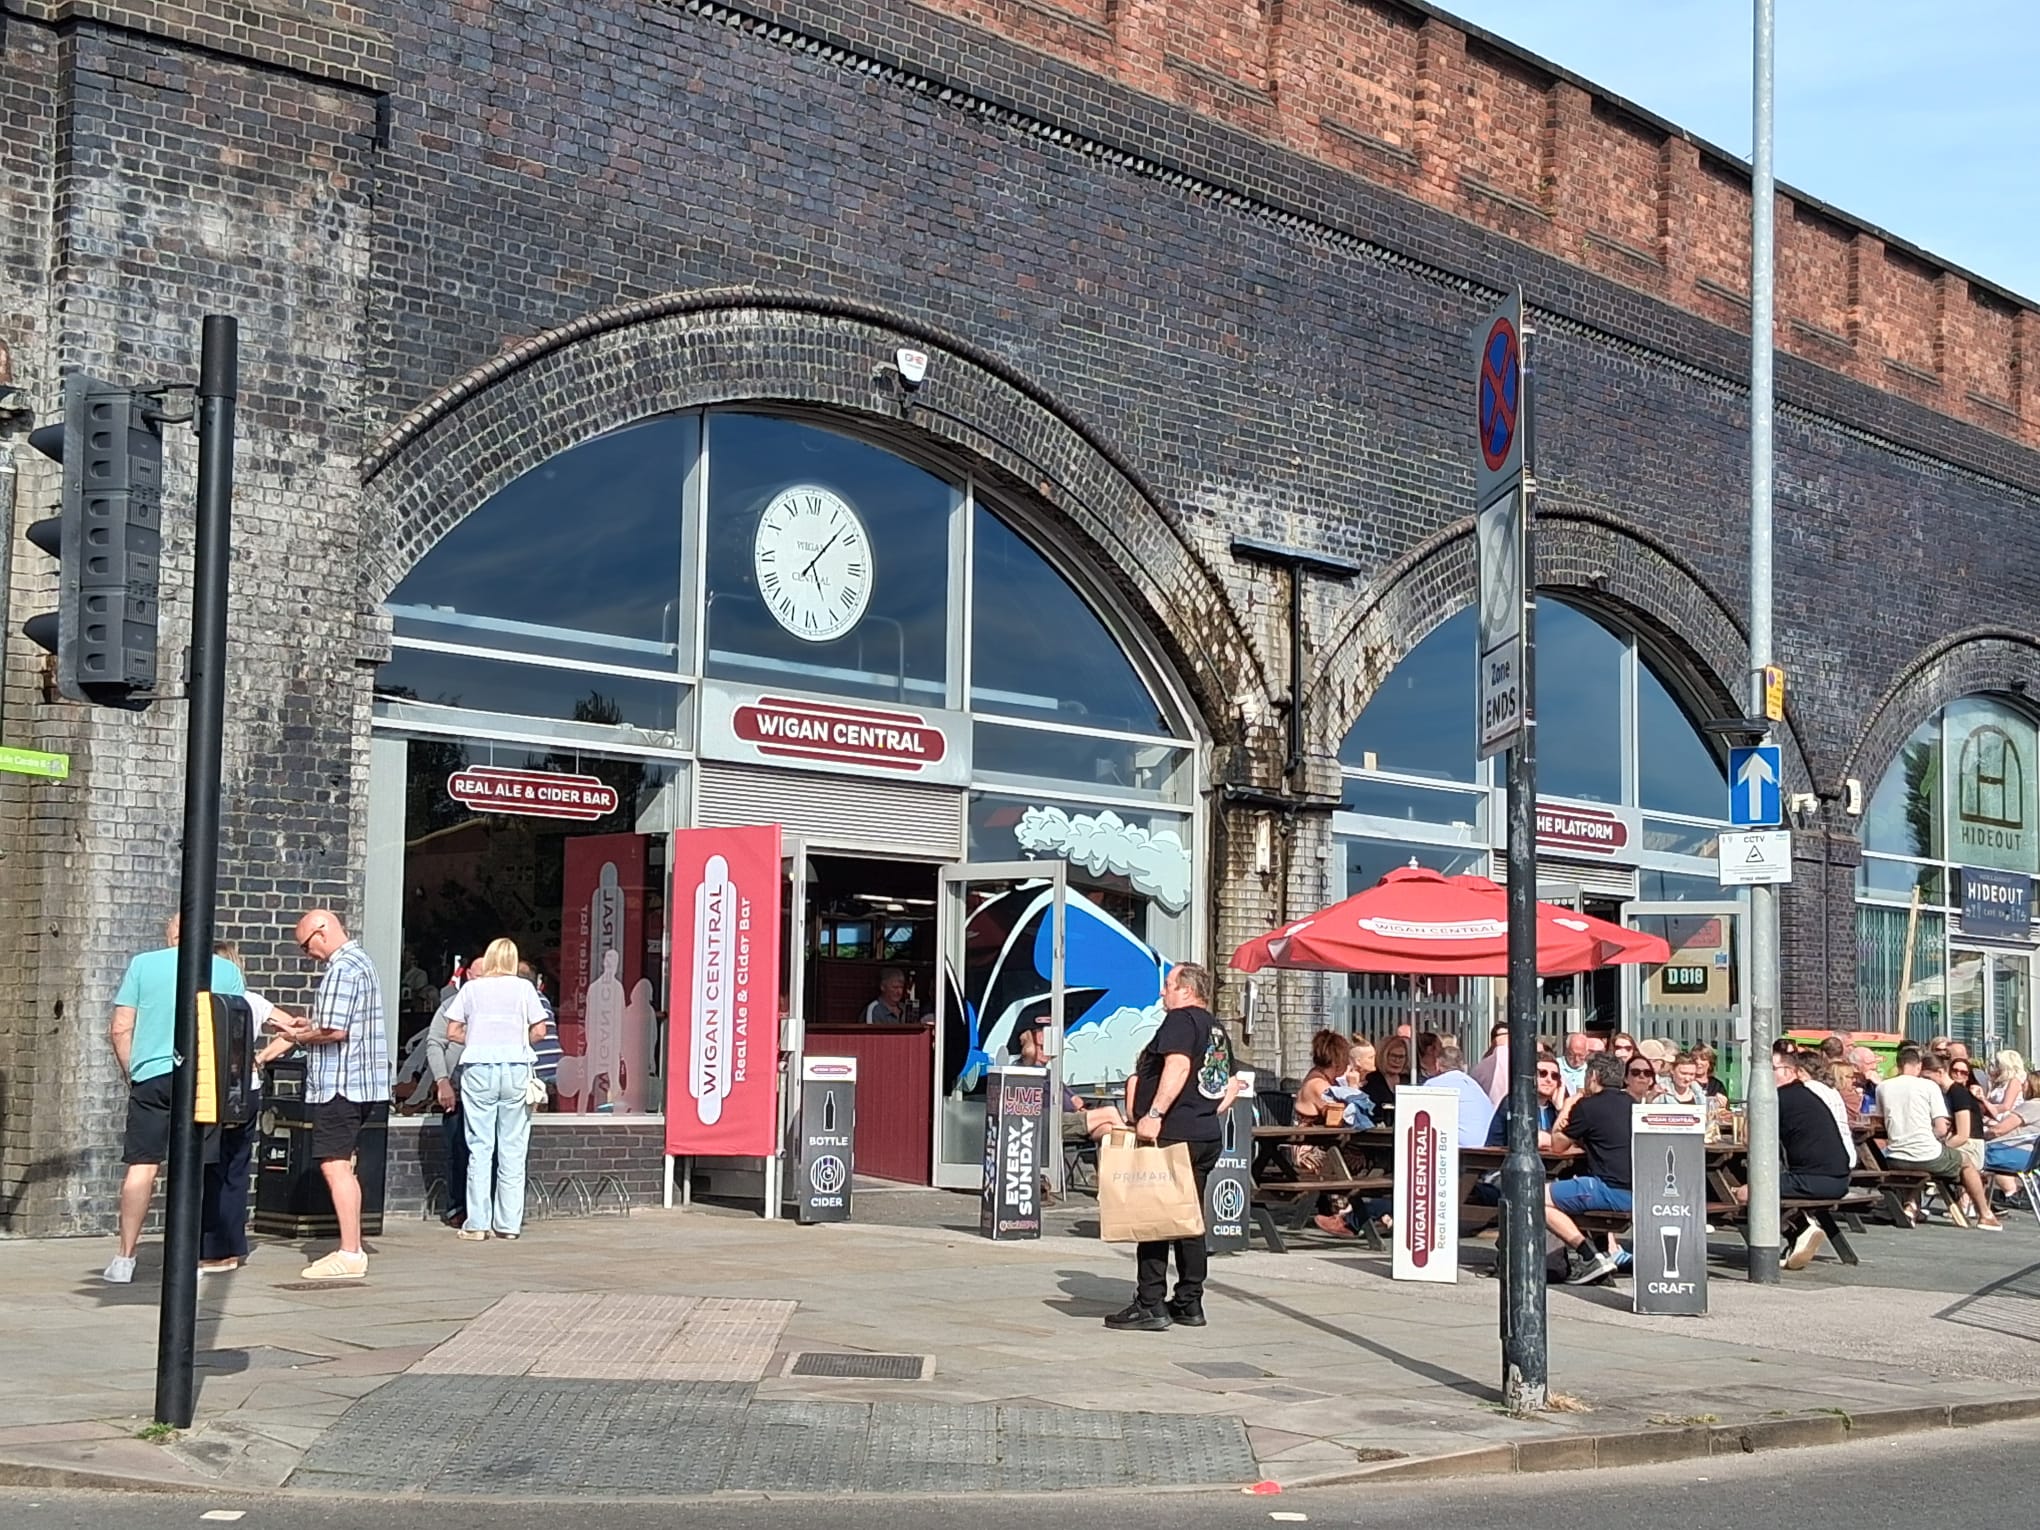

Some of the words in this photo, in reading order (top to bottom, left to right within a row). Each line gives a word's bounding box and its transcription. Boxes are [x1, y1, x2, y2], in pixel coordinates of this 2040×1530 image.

[1491, 661, 1510, 687] Zone
[1486, 687, 1516, 729] ENDS
[756, 713, 829, 742] WIGAN
[833, 723, 925, 753] CENTRAL
[455, 779, 493, 795] REAL
[495, 783, 522, 798] ALE
[524, 787, 535, 799] &
[538, 788, 580, 803] CIDER
[583, 792, 611, 806] BAR
[1536, 816, 1553, 832] HE
[1555, 818, 1613, 840] PLATFORM
[1744, 835, 1765, 843] CCTV
[1962, 827, 2021, 850] HIDEOUT
[1968, 882, 2024, 905] HIDEOUT
[739, 897, 751, 931] Bar
[1375, 923, 1426, 933] WIGAN
[1430, 924, 1497, 934] CENTRAL
[706, 883, 723, 1002] CENTRAL
[738, 937, 749, 985] Cider
[738, 990, 748, 1005] &
[737, 1010, 748, 1037] Ale
[703, 1008, 719, 1095] WIGAN
[735, 1040, 747, 1082] Real
[1004, 1086, 1043, 1102] LIVE
[809, 1136, 849, 1146] BOTTLE
[1439, 1131, 1448, 1151] Bar
[1005, 1125, 1021, 1206] EVERY
[1019, 1117, 1035, 1215] SUNDAY
[1416, 1126, 1428, 1196] CENTRAL
[1438, 1159, 1447, 1187] Cider
[810, 1197, 844, 1208] CIDER
[1439, 1189, 1447, 1197] &
[1439, 1202, 1447, 1219] Ale
[1652, 1205, 1691, 1217] CASK
[1213, 1225, 1242, 1236] CIDER
[1415, 1200, 1428, 1252] WIGAN
[1438, 1224, 1446, 1249] Real
[1648, 1282, 1696, 1295] CRAFT
